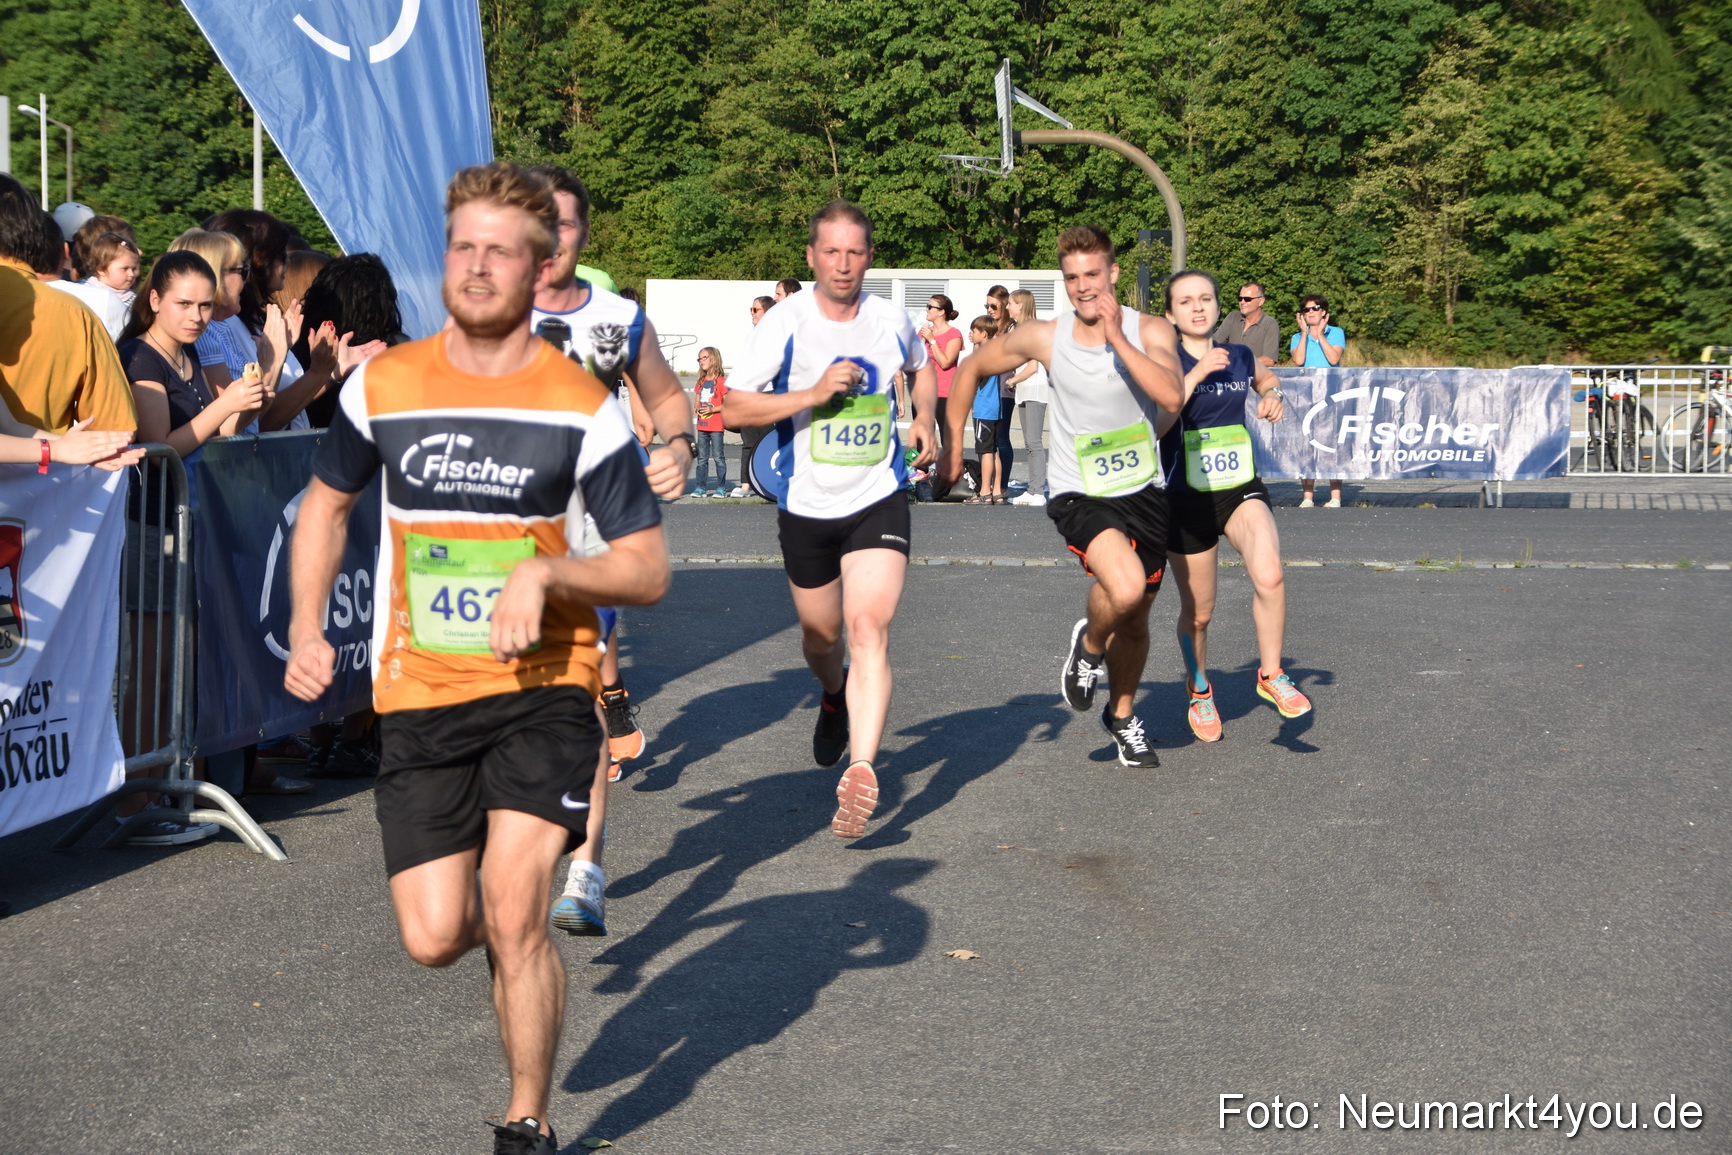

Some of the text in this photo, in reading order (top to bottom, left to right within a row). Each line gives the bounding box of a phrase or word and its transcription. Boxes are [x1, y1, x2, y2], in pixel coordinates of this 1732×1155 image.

[1192, 384, 1216, 394] URO
[820, 422, 883, 447] 1482
[1337, 415, 1500, 446] Fischer
[1095, 450, 1140, 476] 353
[1200, 451, 1240, 474] 368
[1351, 449, 1487, 463] AUTOMOBILE
[422, 454, 536, 487] Fischer
[433, 481, 523, 500] AUTOMOBILE
[0, 721, 70, 793] bräu
